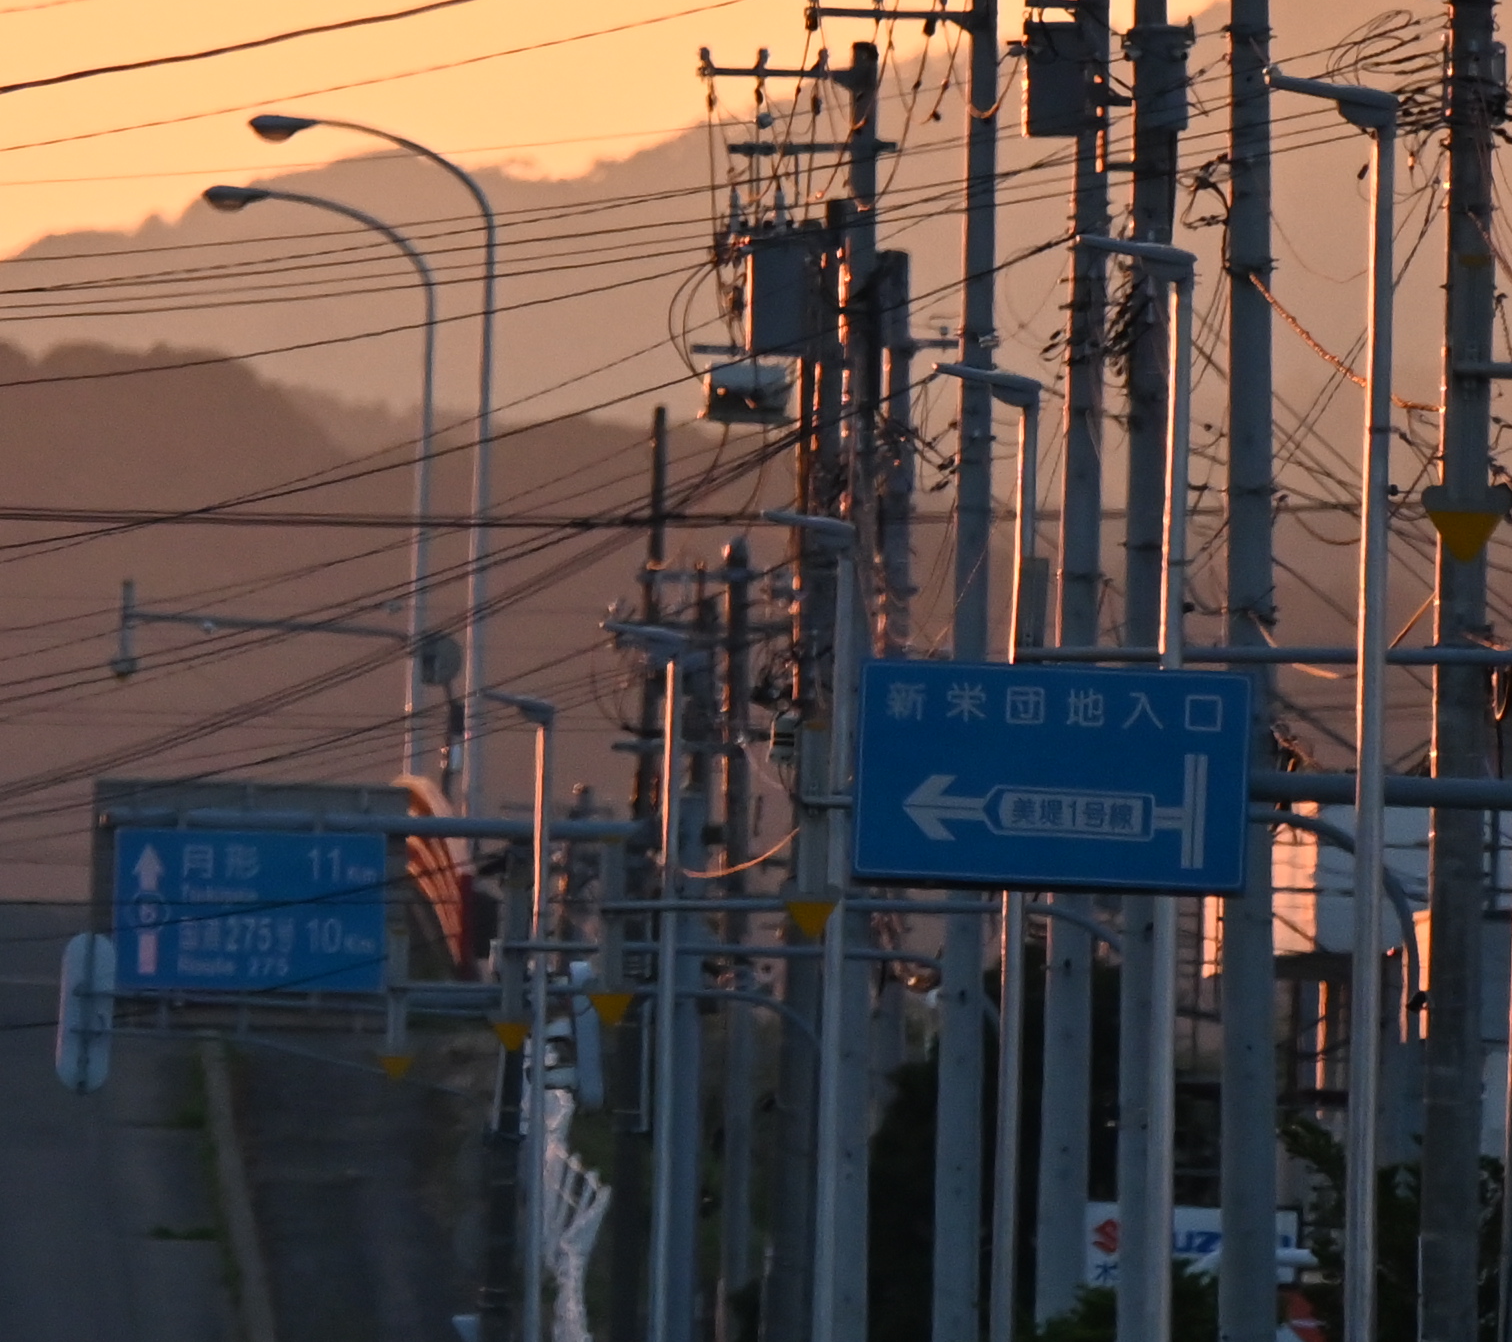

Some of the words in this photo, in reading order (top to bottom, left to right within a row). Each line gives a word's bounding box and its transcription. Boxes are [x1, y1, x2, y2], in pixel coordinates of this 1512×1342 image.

[885, 681, 1223, 732] 新栄団地入口
[307, 847, 342, 883] 11
[306, 917, 343, 954] 10
